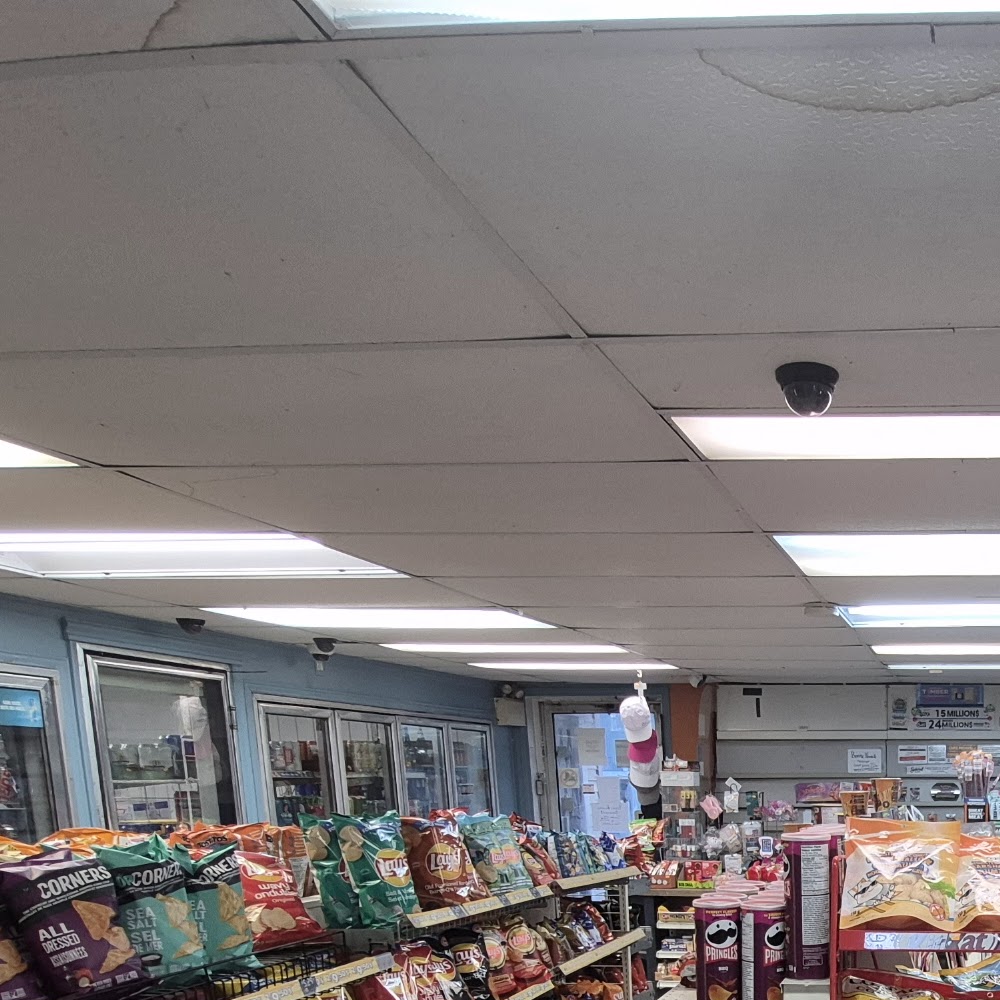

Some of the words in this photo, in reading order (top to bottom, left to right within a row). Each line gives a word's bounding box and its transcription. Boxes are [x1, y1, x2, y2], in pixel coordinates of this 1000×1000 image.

[37, 865, 112, 899] CORNERS
[126, 907, 156, 920] SEA
[39, 923, 75, 941] ALL
[128, 920, 157, 931] SALT
[42, 933, 81, 954] DRESSED
[132, 929, 161, 942] SEL
[705, 944, 738, 961] PRINGLES
